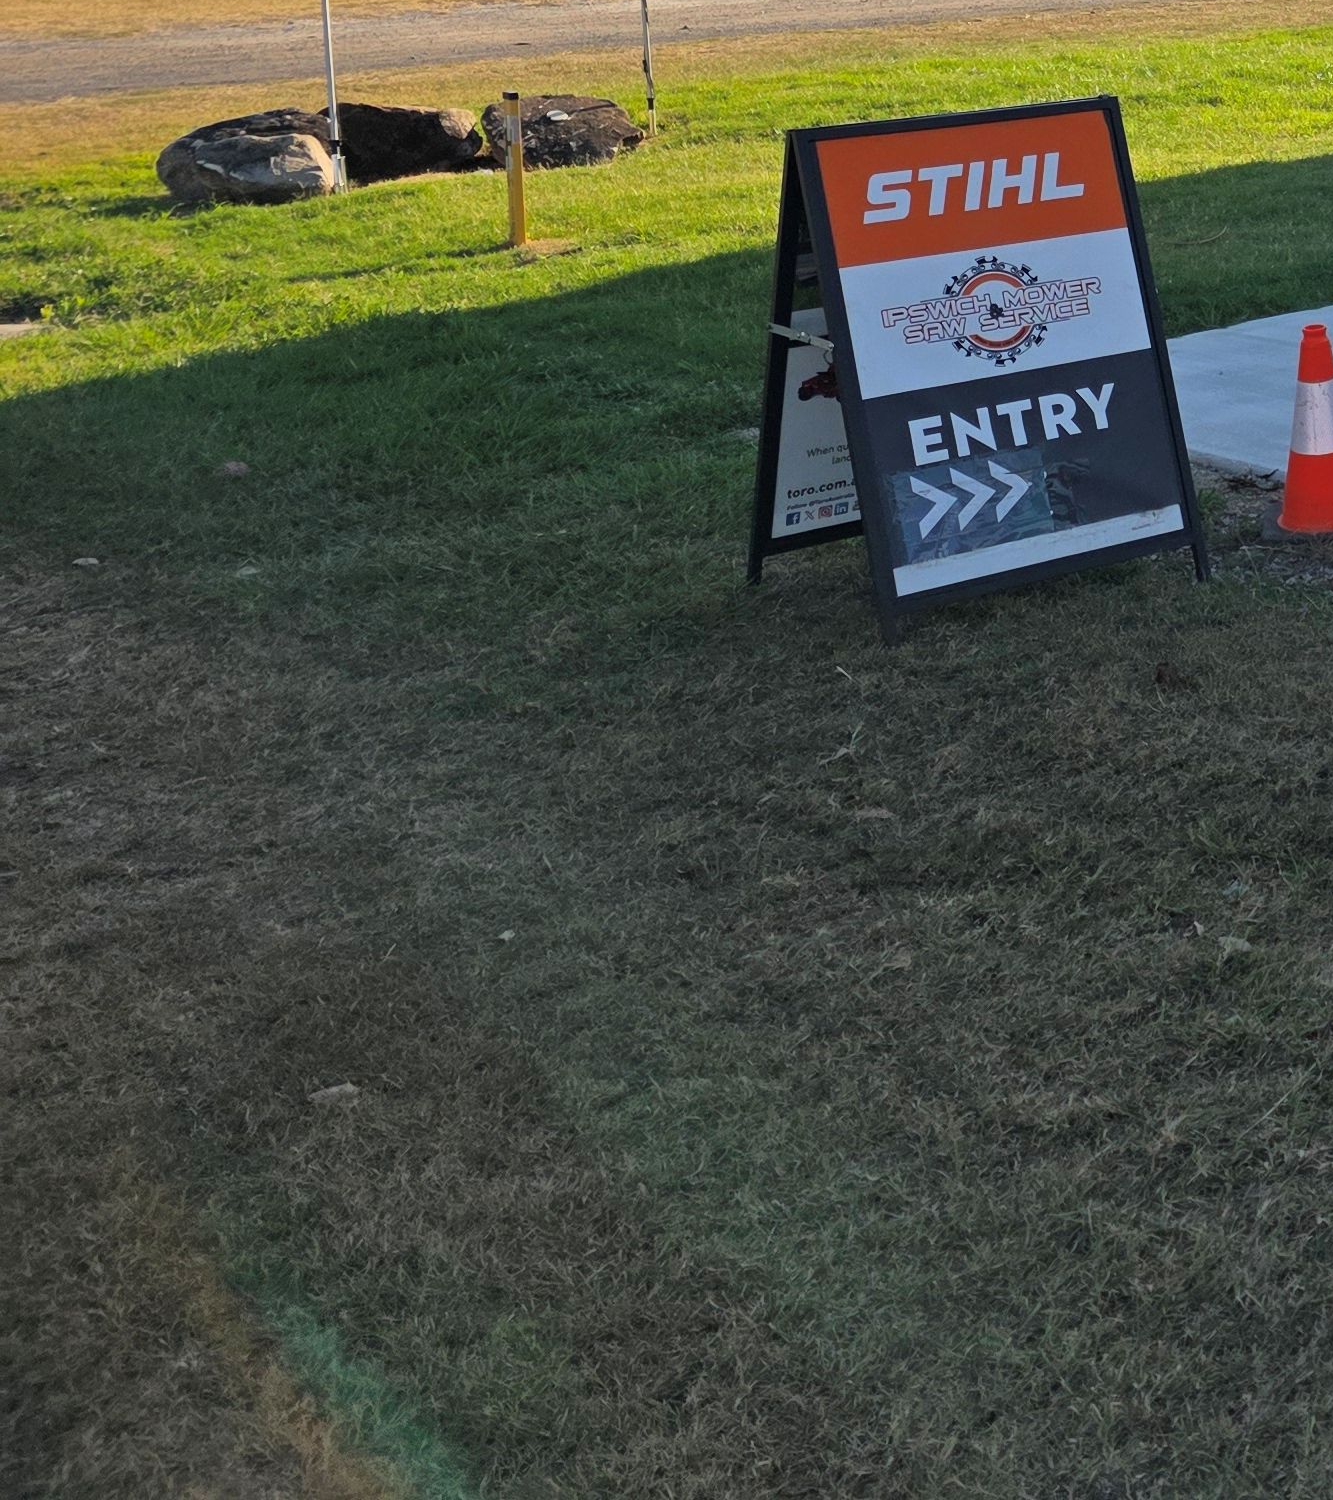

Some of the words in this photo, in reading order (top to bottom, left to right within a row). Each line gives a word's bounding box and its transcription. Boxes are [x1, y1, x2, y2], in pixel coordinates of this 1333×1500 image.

[863, 152, 1086, 225] STIHL
[881, 293, 992, 328] IPSWICH
[1003, 277, 1102, 309] MOWER
[902, 317, 966, 345] SAW
[979, 298, 1091, 332] SERVICE
[908, 383, 1116, 466] ENTRY
[806, 446, 834, 458] When
